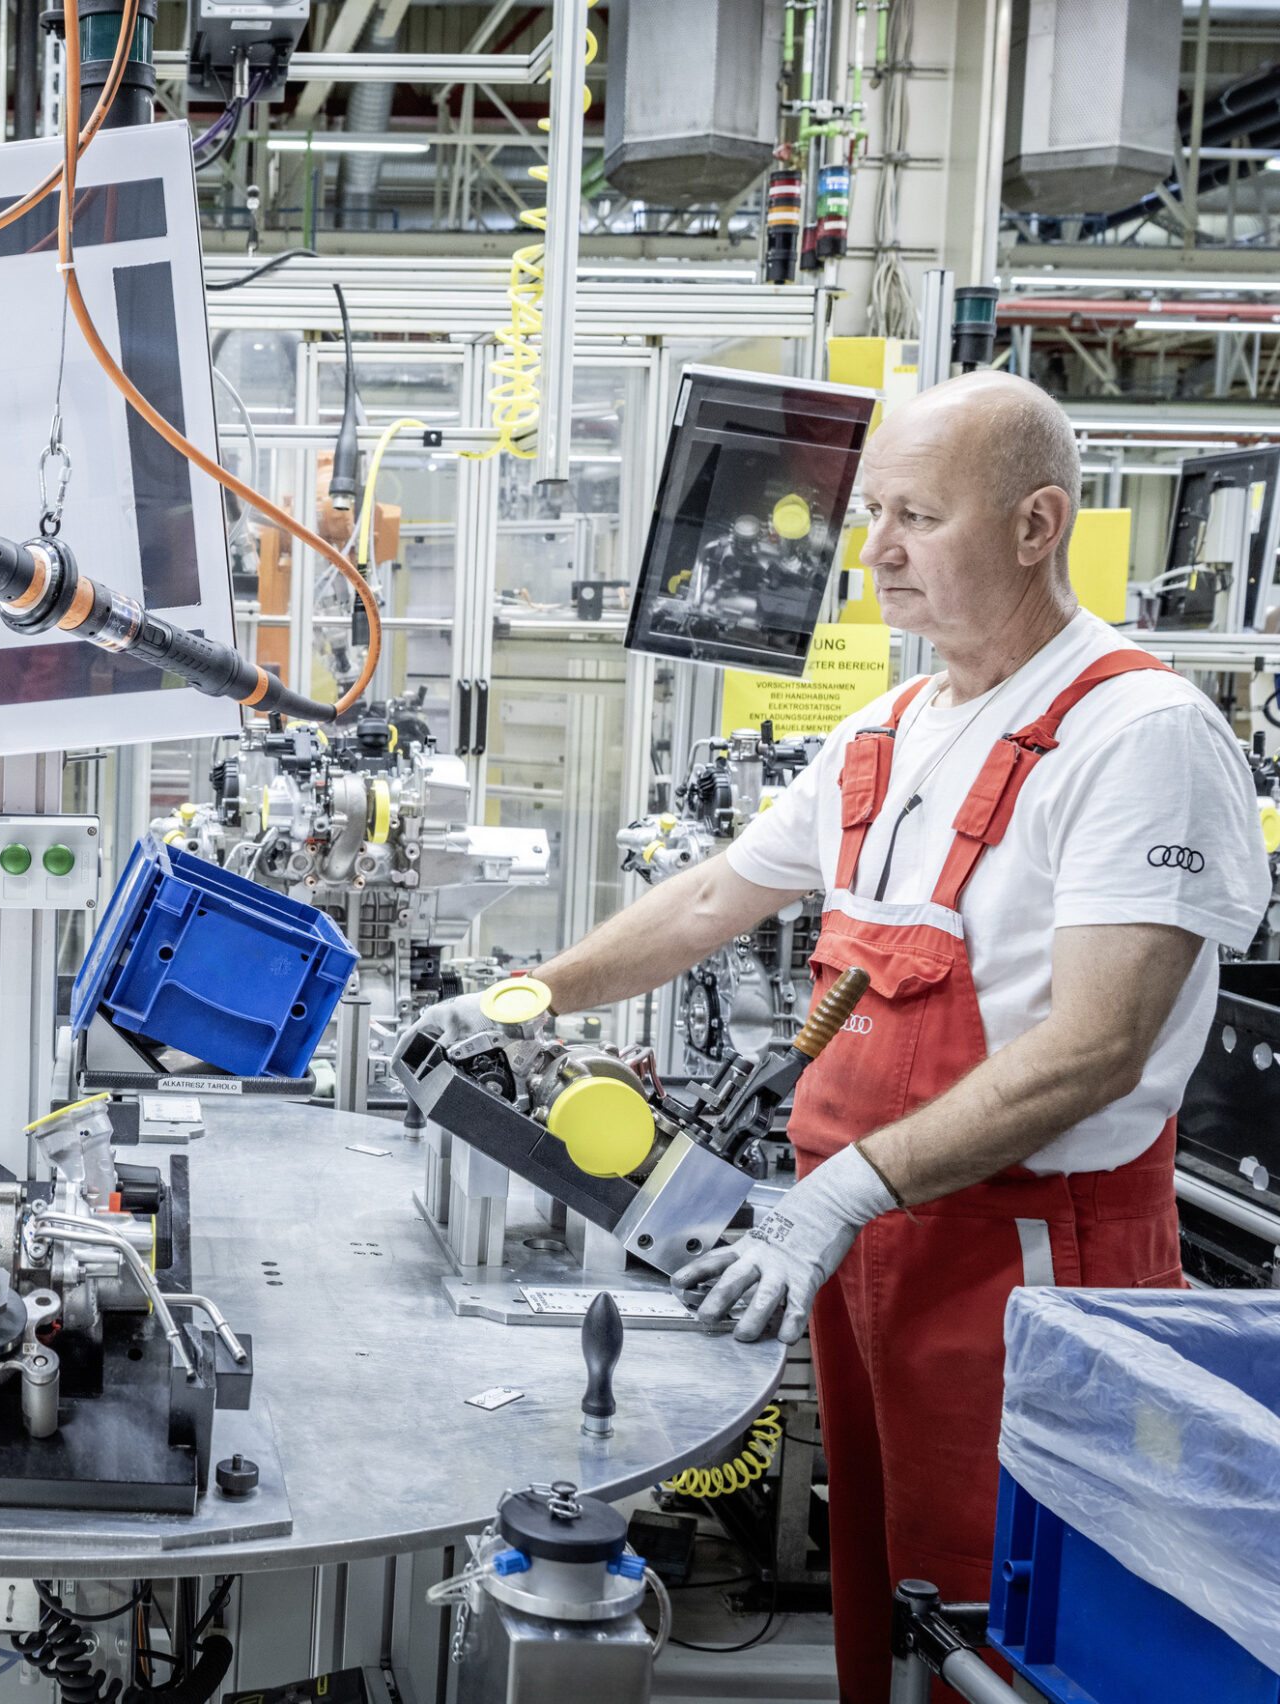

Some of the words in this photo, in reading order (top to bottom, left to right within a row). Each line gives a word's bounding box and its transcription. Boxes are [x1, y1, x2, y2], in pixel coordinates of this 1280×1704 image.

[838, 660, 885, 671] BEREICH
[756, 681, 856, 691] VORSICHTSMASSNAHMEN
[785, 693, 840, 701] HANDHABUNG
[768, 703, 841, 711] ELEKTROSTATISCH
[775, 723, 832, 732] BAUELEMENTE
